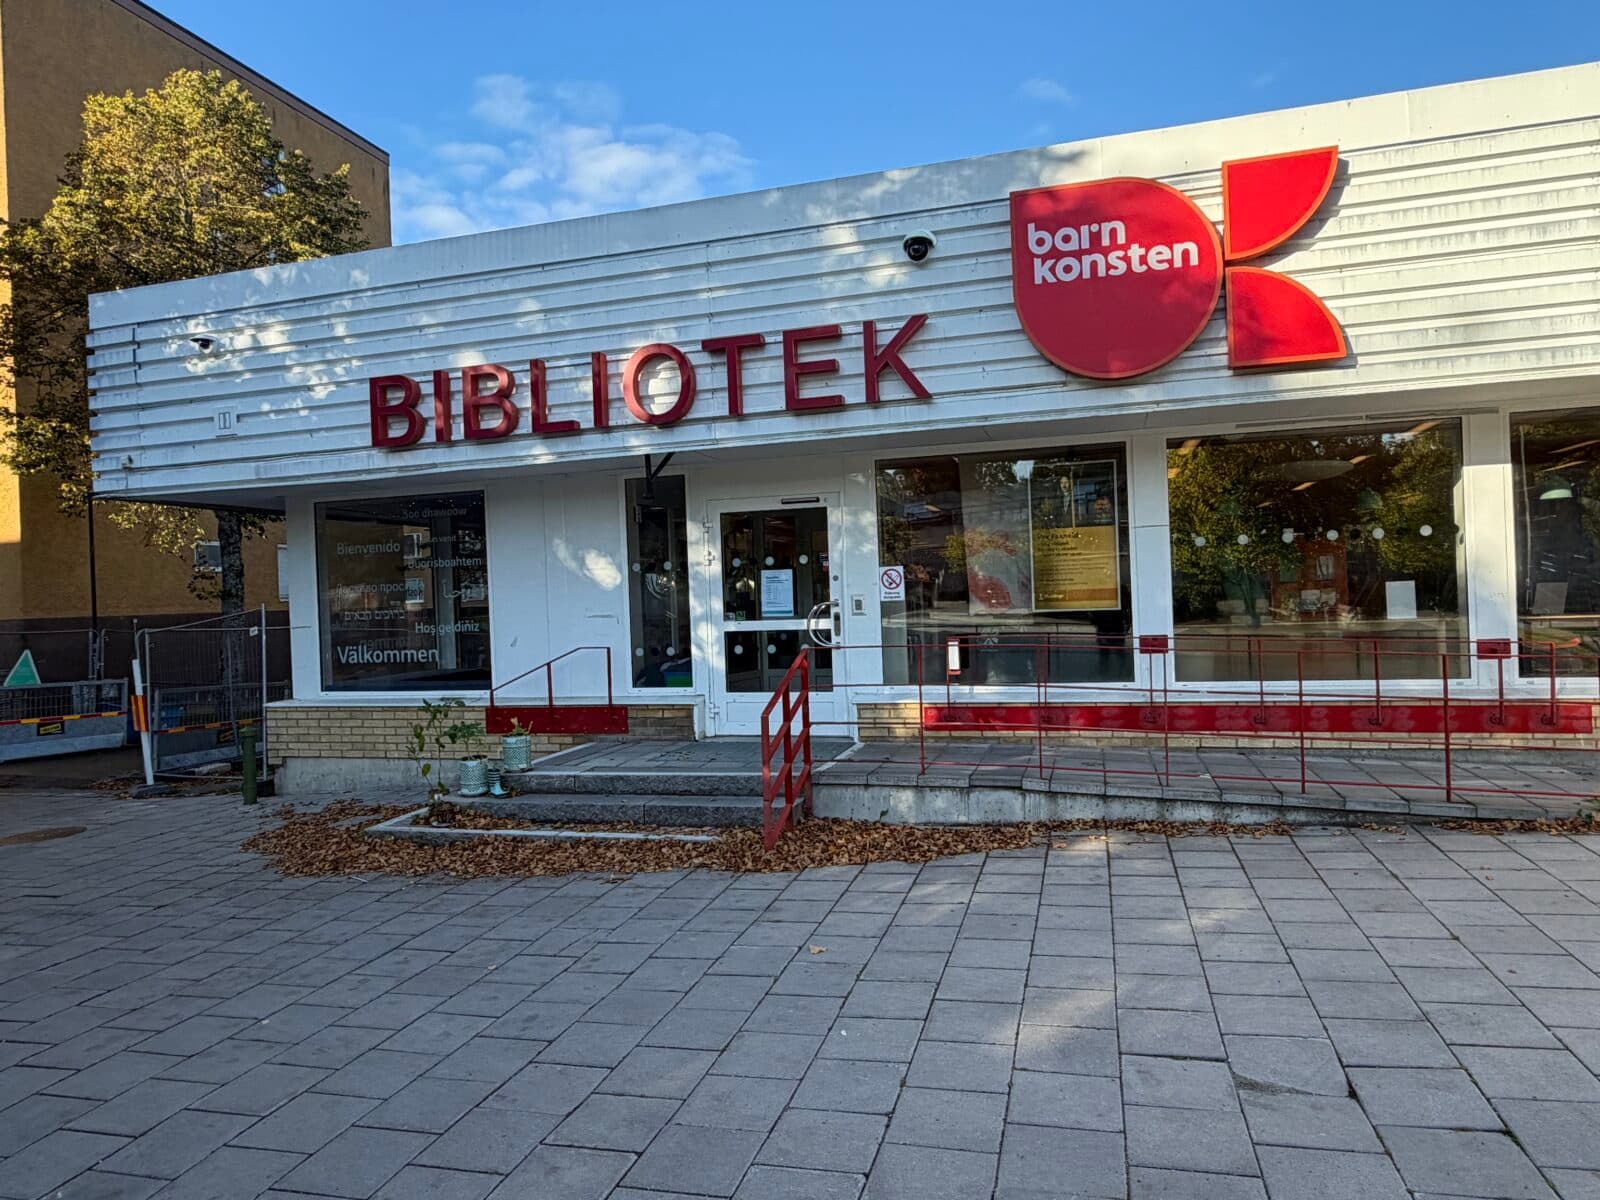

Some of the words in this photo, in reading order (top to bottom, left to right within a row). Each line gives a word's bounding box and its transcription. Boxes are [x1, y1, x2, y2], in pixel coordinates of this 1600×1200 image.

[1027, 220, 1126, 255] barn
[1033, 241, 1199, 285] konsten
[369, 313, 933, 449] BIBLIOTEK
[337, 539, 401, 555] Bienvenido
[337, 646, 440, 665] Välkommen
